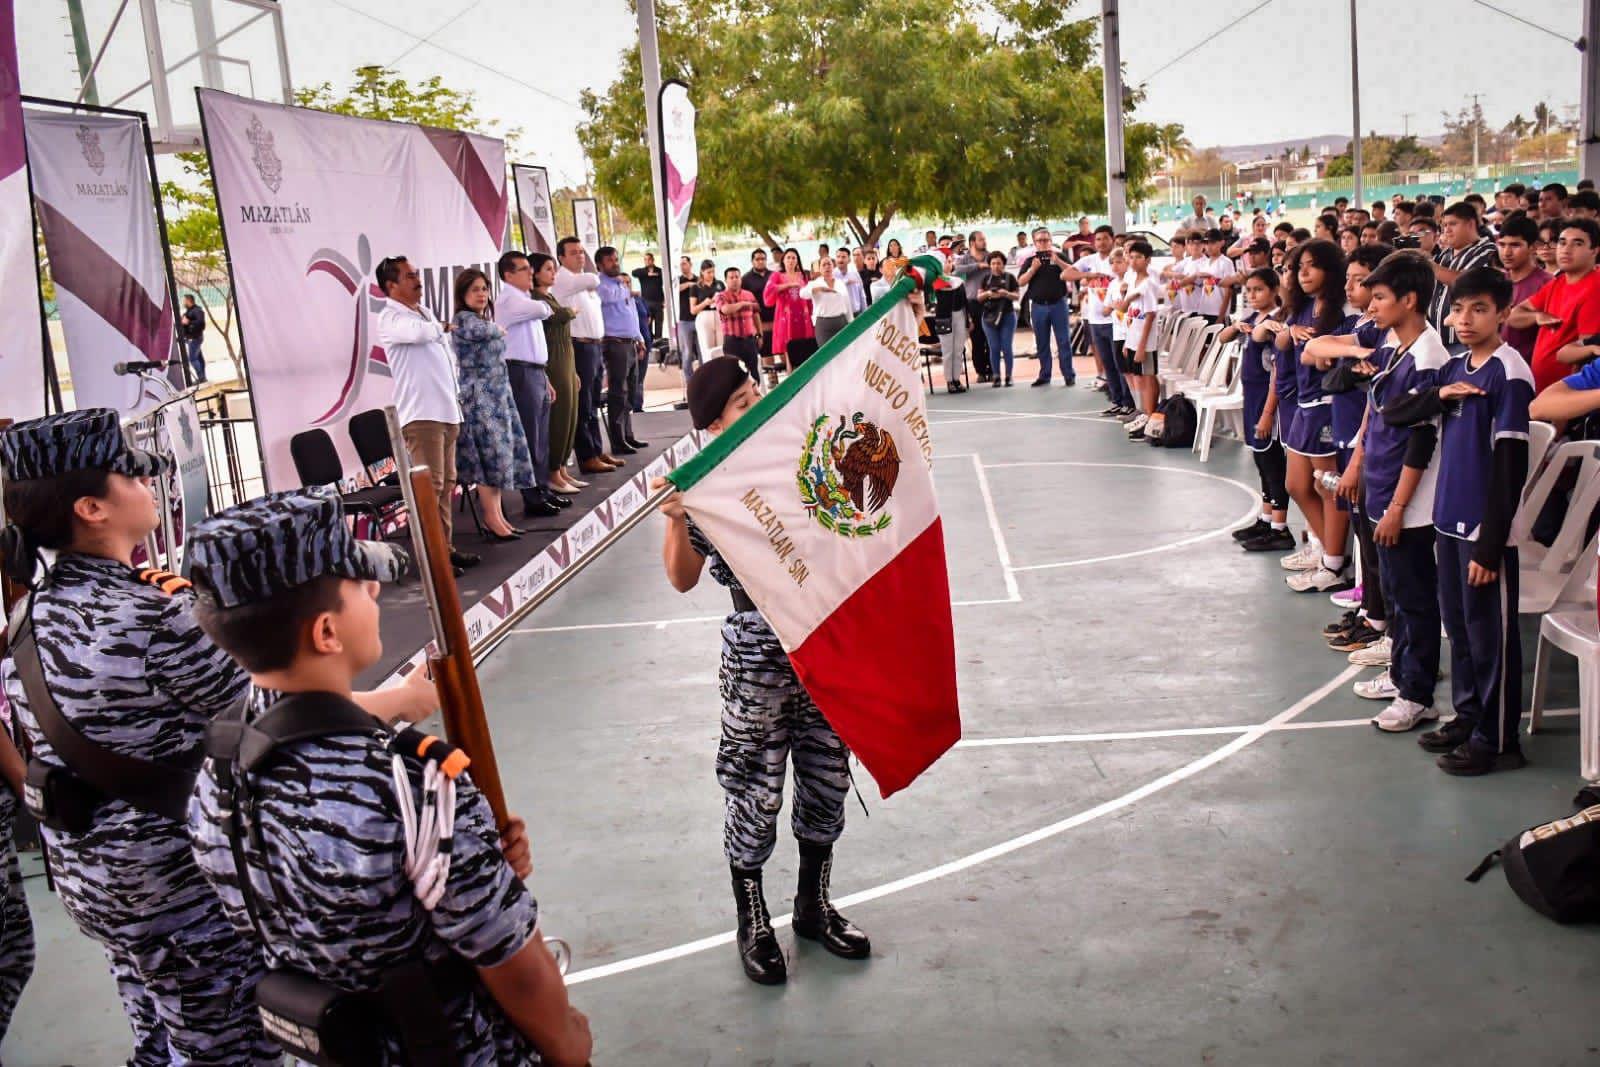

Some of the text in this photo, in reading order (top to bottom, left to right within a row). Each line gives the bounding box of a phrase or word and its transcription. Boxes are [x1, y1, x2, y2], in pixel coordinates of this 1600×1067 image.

[239, 202, 312, 224] MAZATLÁN
[876, 318, 920, 371] COLEGIO
[864, 359, 933, 473] NUEVO MEXIC
[740, 487, 810, 589] MAZATLAN, SIN.
[467, 617, 483, 643] DEM
